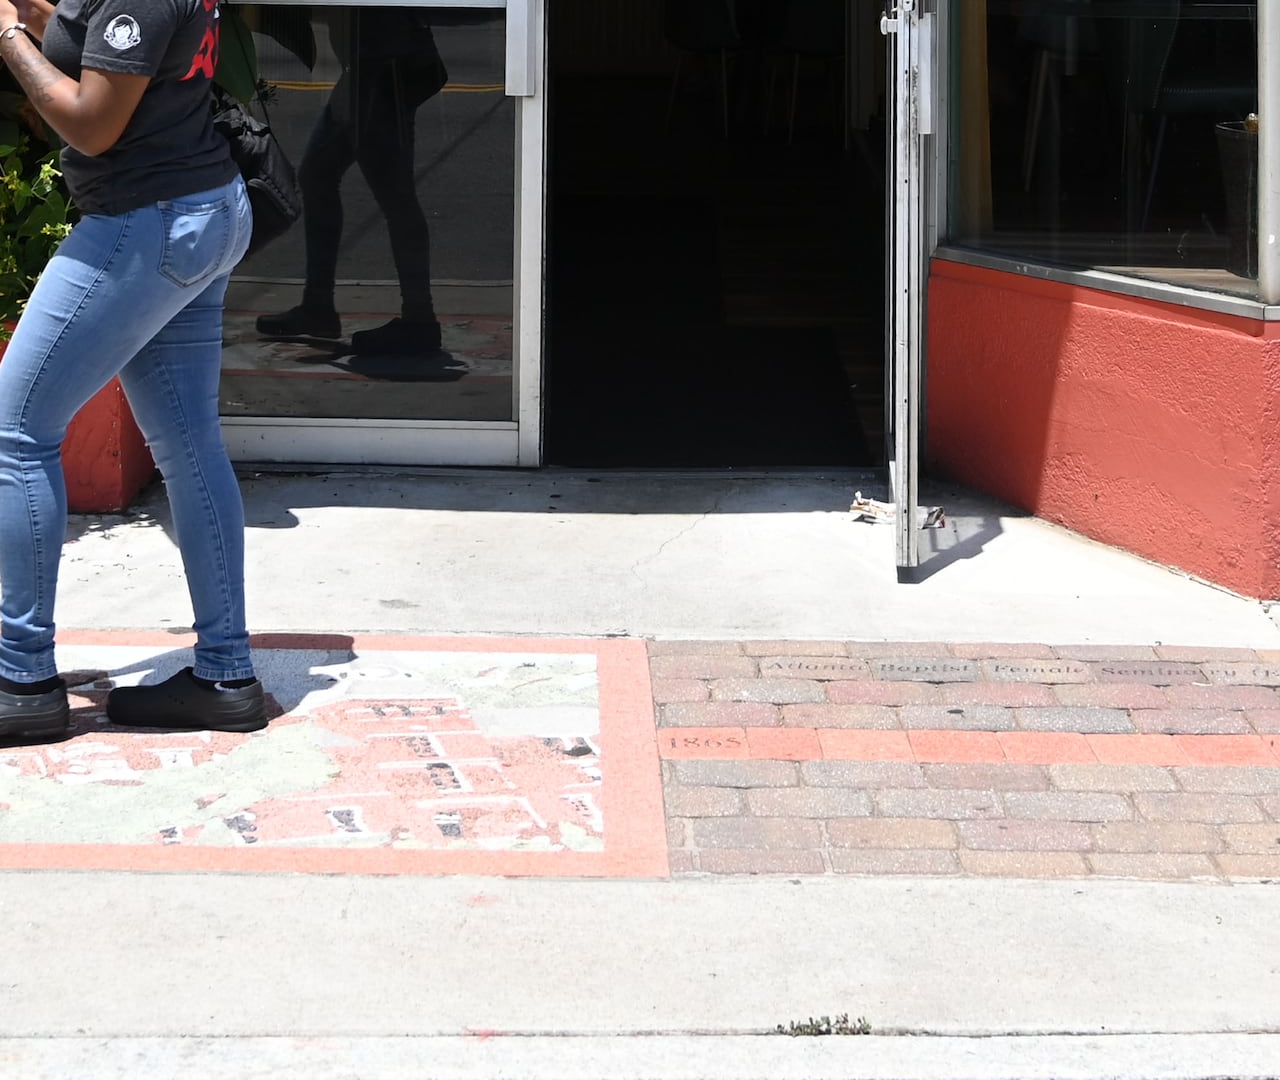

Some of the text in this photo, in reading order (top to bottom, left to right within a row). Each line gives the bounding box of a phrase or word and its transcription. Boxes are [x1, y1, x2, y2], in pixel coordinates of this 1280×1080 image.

[766, 660, 866, 673] Atlanta
[879, 663, 971, 675] Baptist
[993, 663, 1087, 675] Female
[1101, 666, 1238, 679] Seminary
